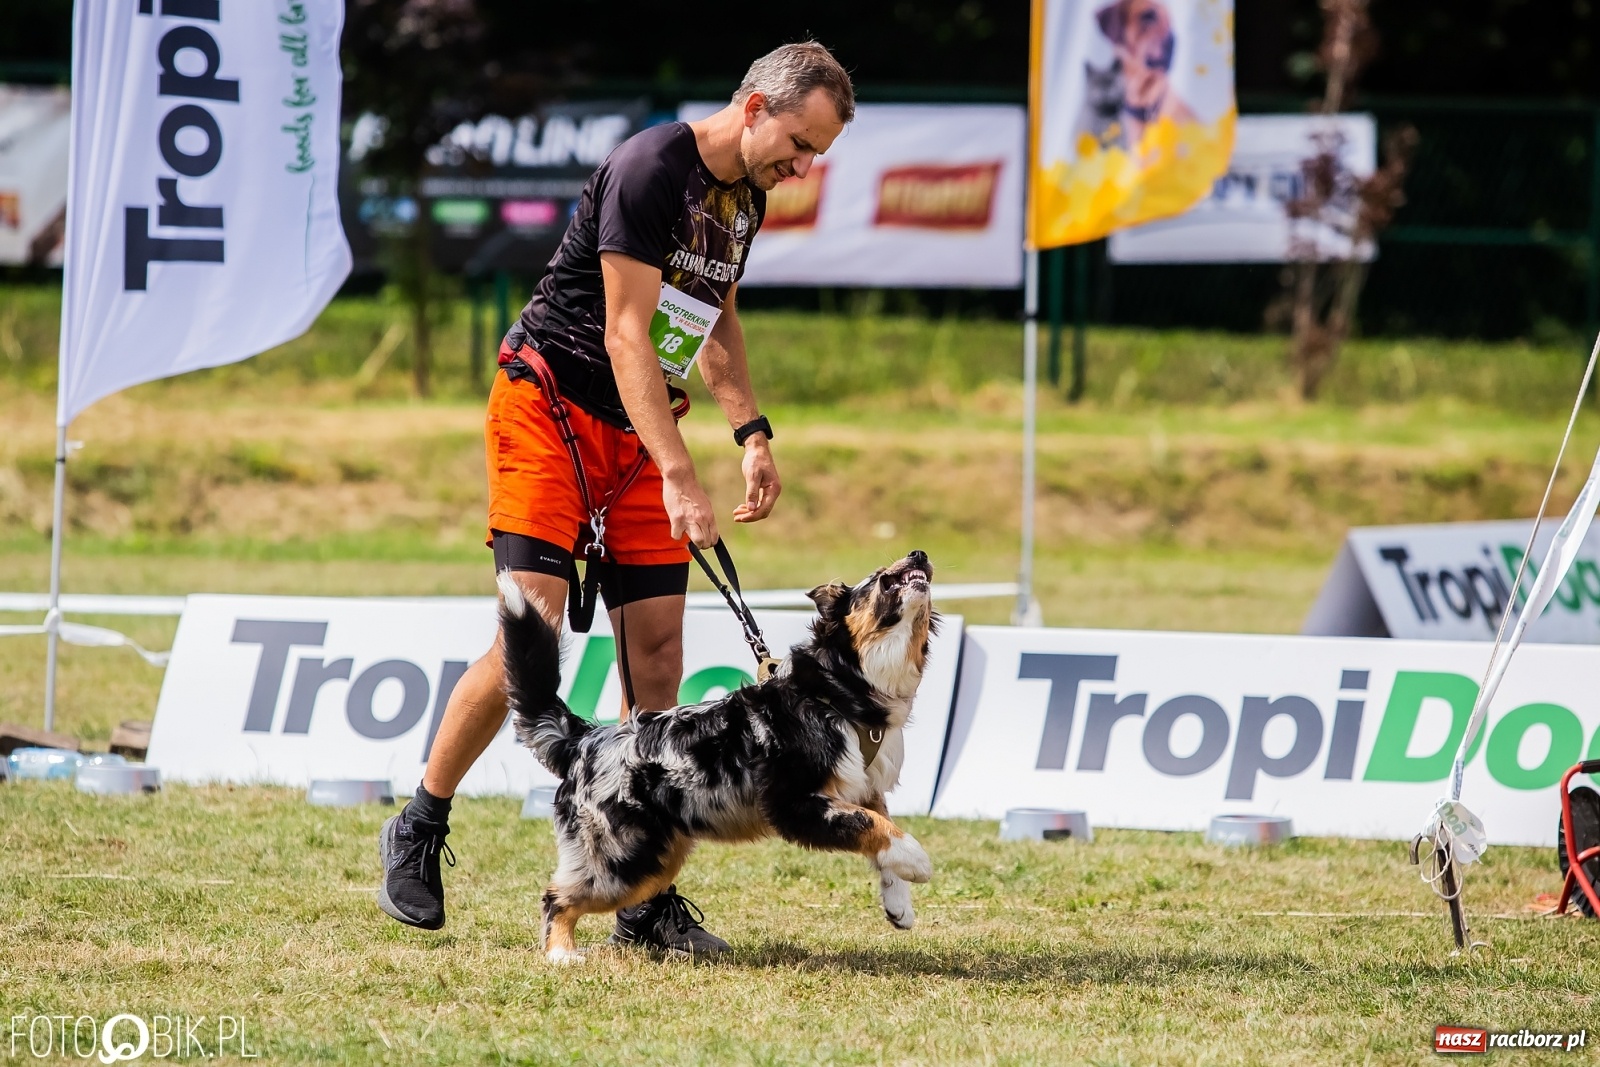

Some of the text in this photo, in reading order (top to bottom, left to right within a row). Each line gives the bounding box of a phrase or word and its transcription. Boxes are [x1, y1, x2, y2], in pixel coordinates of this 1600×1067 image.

[660, 300, 711, 328] DOGTREKKING
[658, 333, 684, 354] 18
[1018, 653, 1600, 800] TropiDo
